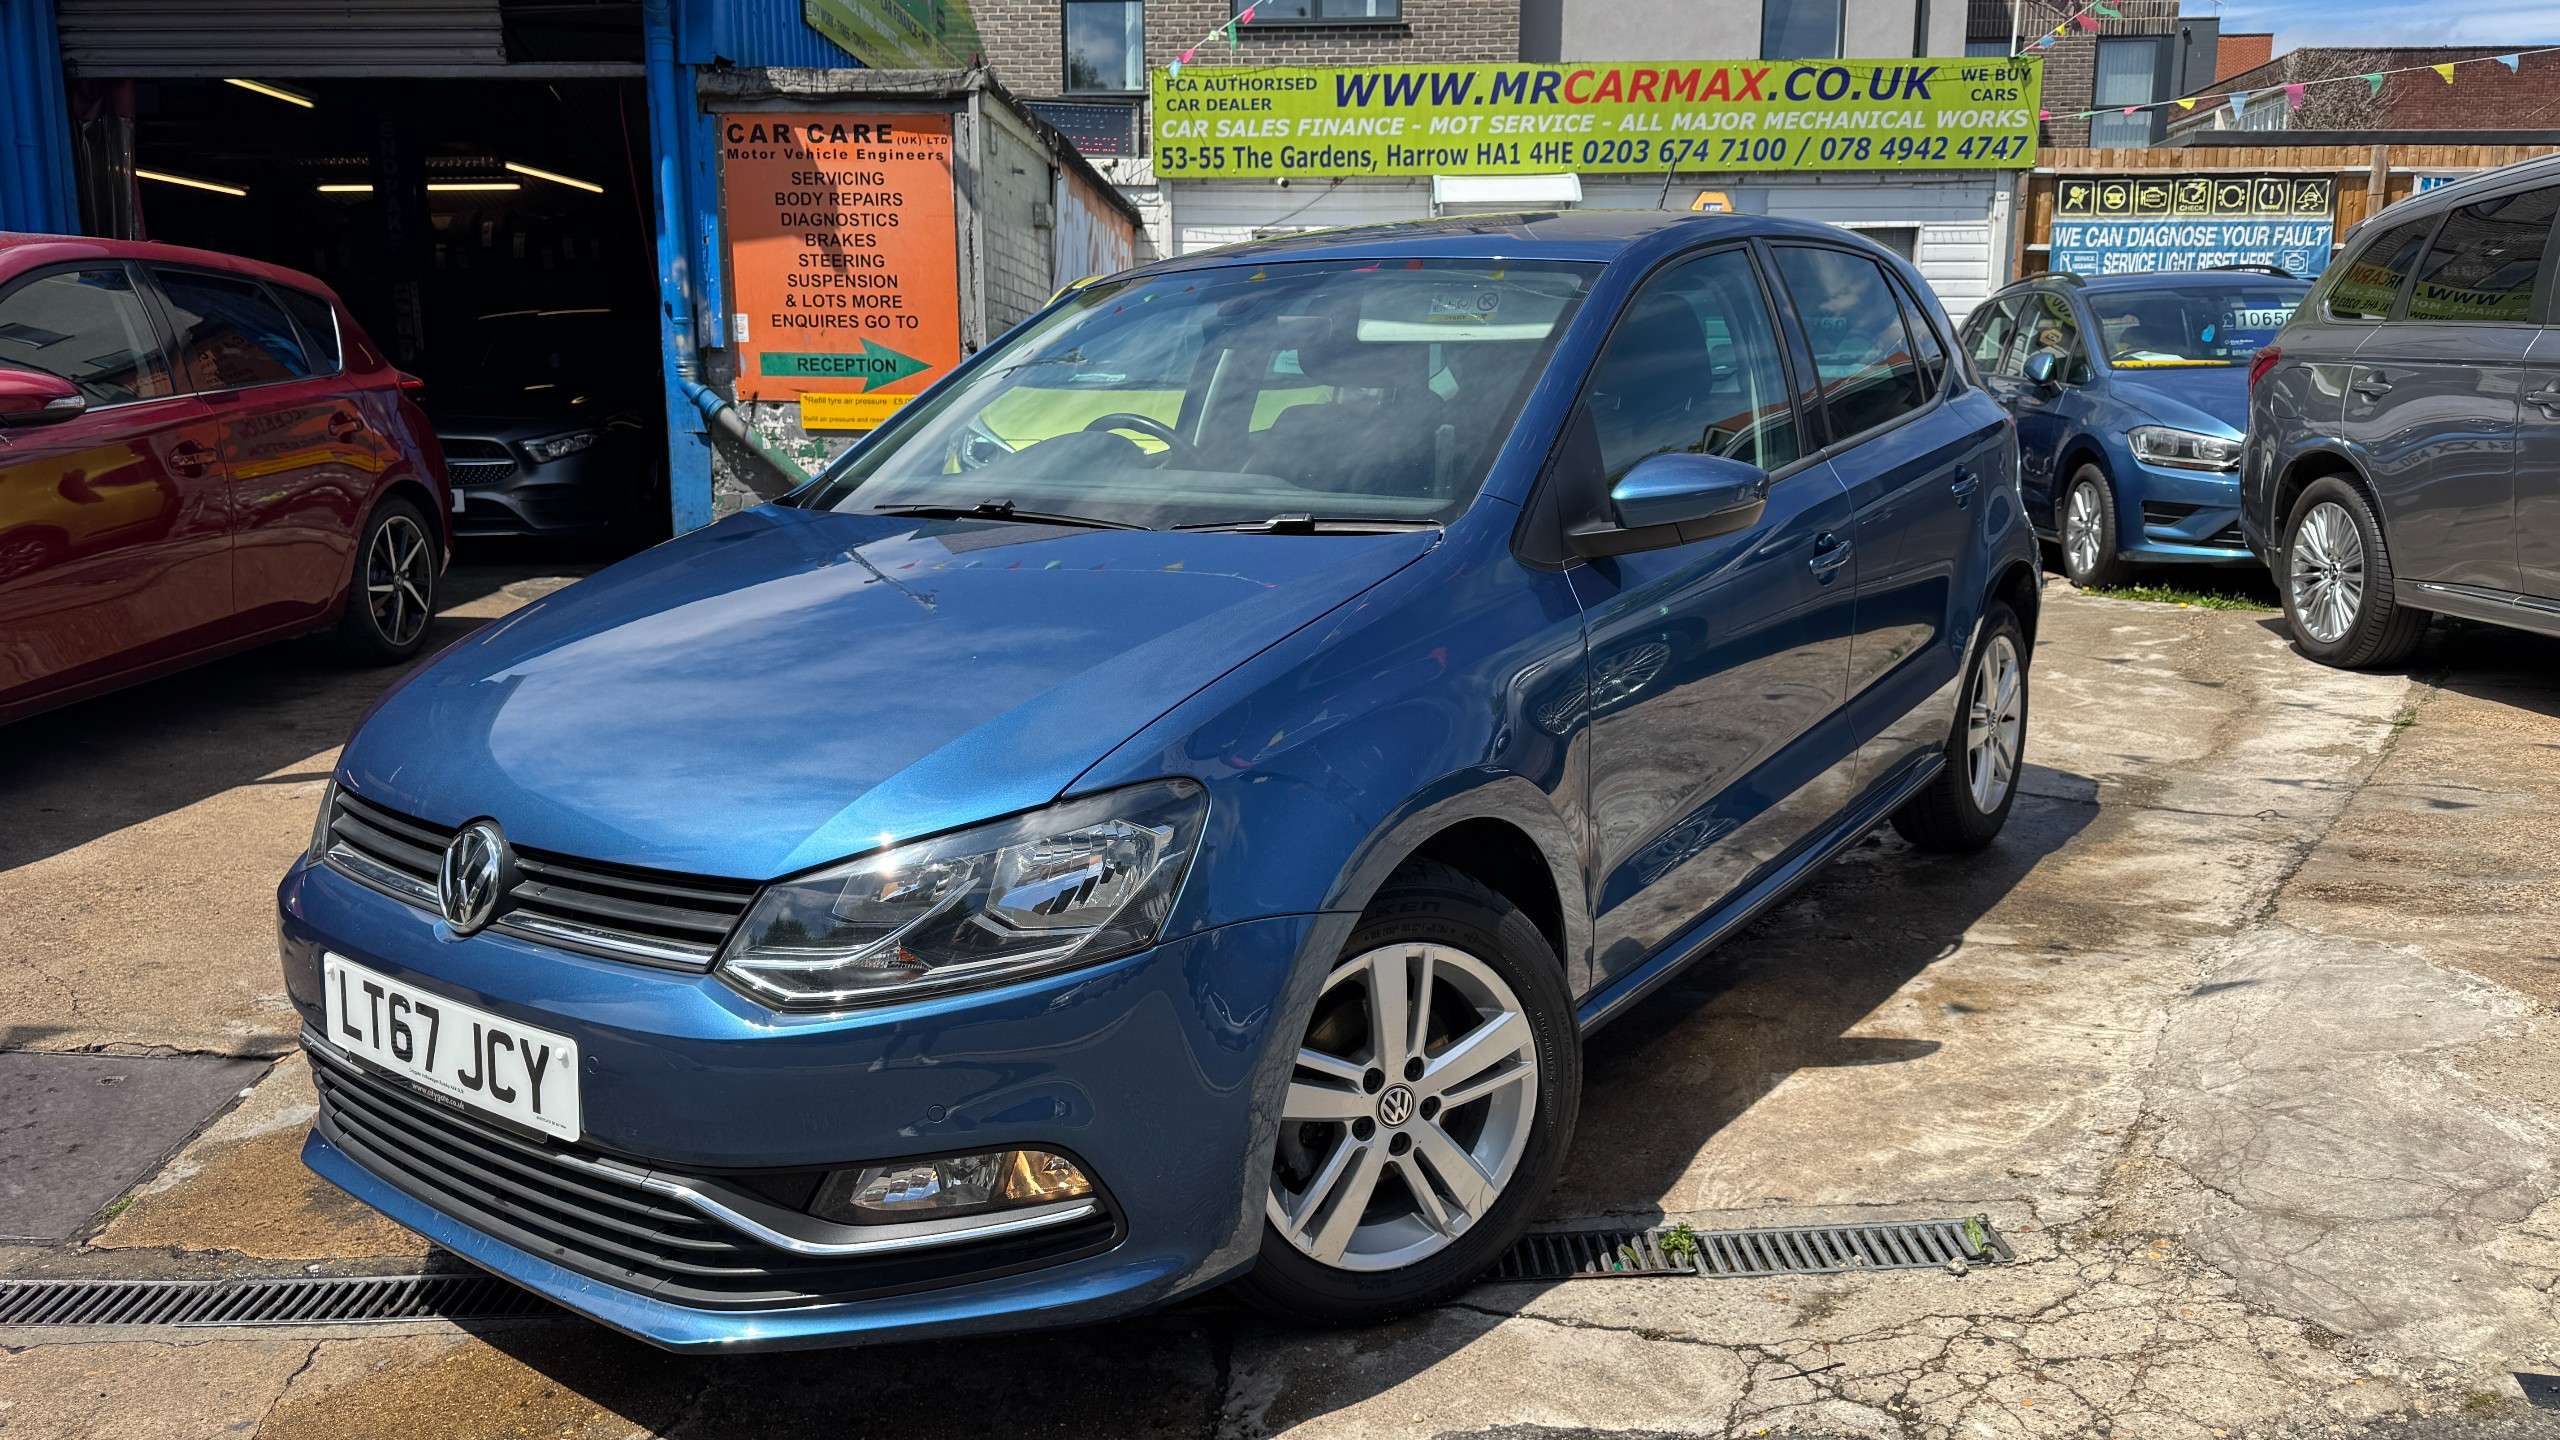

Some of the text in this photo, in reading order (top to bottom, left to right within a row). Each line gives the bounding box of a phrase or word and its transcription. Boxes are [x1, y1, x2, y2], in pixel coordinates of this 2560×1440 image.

[1961, 68, 2032, 82] WE BUY
[1166, 77, 1318, 92] FCA AUTHORISED
[1335, 66, 1940, 107] WWW.MRCARMAX.CO.UK
[1971, 88, 2018, 102] CARS
[1166, 98, 1272, 112] CAR DEALER
[1161, 119, 1208, 138] CAR
[1215, 118, 1290, 138] SALES
[1296, 116, 1405, 136] FINANCE
[1429, 115, 1485, 135] MOT
[1488, 114, 1595, 134] SERVICE
[1618, 113, 1663, 132] ALL
[1671, 112, 1756, 132] MAJOR
[1763, 110, 1925, 130] MECHANICAL
[1936, 108, 2029, 128] WORKS
[726, 123, 948, 146] CAR CARE (UK) LTD
[727, 148, 944, 162] Motor Vehicle Engineers
[1161, 135, 2028, 172] 53-55 The Gardens, Harrow HA1 4HE 0203 674 7100 / 078 4942 4747
[791, 171, 885, 186] SERVICING
[775, 192, 904, 207] BODY REPAIRS
[2179, 204, 2205, 212] CHECK
[781, 212, 899, 227] DIAGNOSTICS
[805, 233, 876, 248] BRAKES
[2055, 225, 2327, 247] WE CAN DIAGNOSE YOUR FAULT
[798, 253, 885, 268] STEERING
[2103, 251, 2274, 274] SERVICE LIGHT RESET HERE
[787, 274, 898, 288] SUSPENSION
[785, 294, 903, 309] & LOTS MORE
[771, 314, 919, 329] ENQUIRES GO TO
[797, 357, 897, 373] RECEPTION
[339, 969, 550, 1115] LT67 JCY
